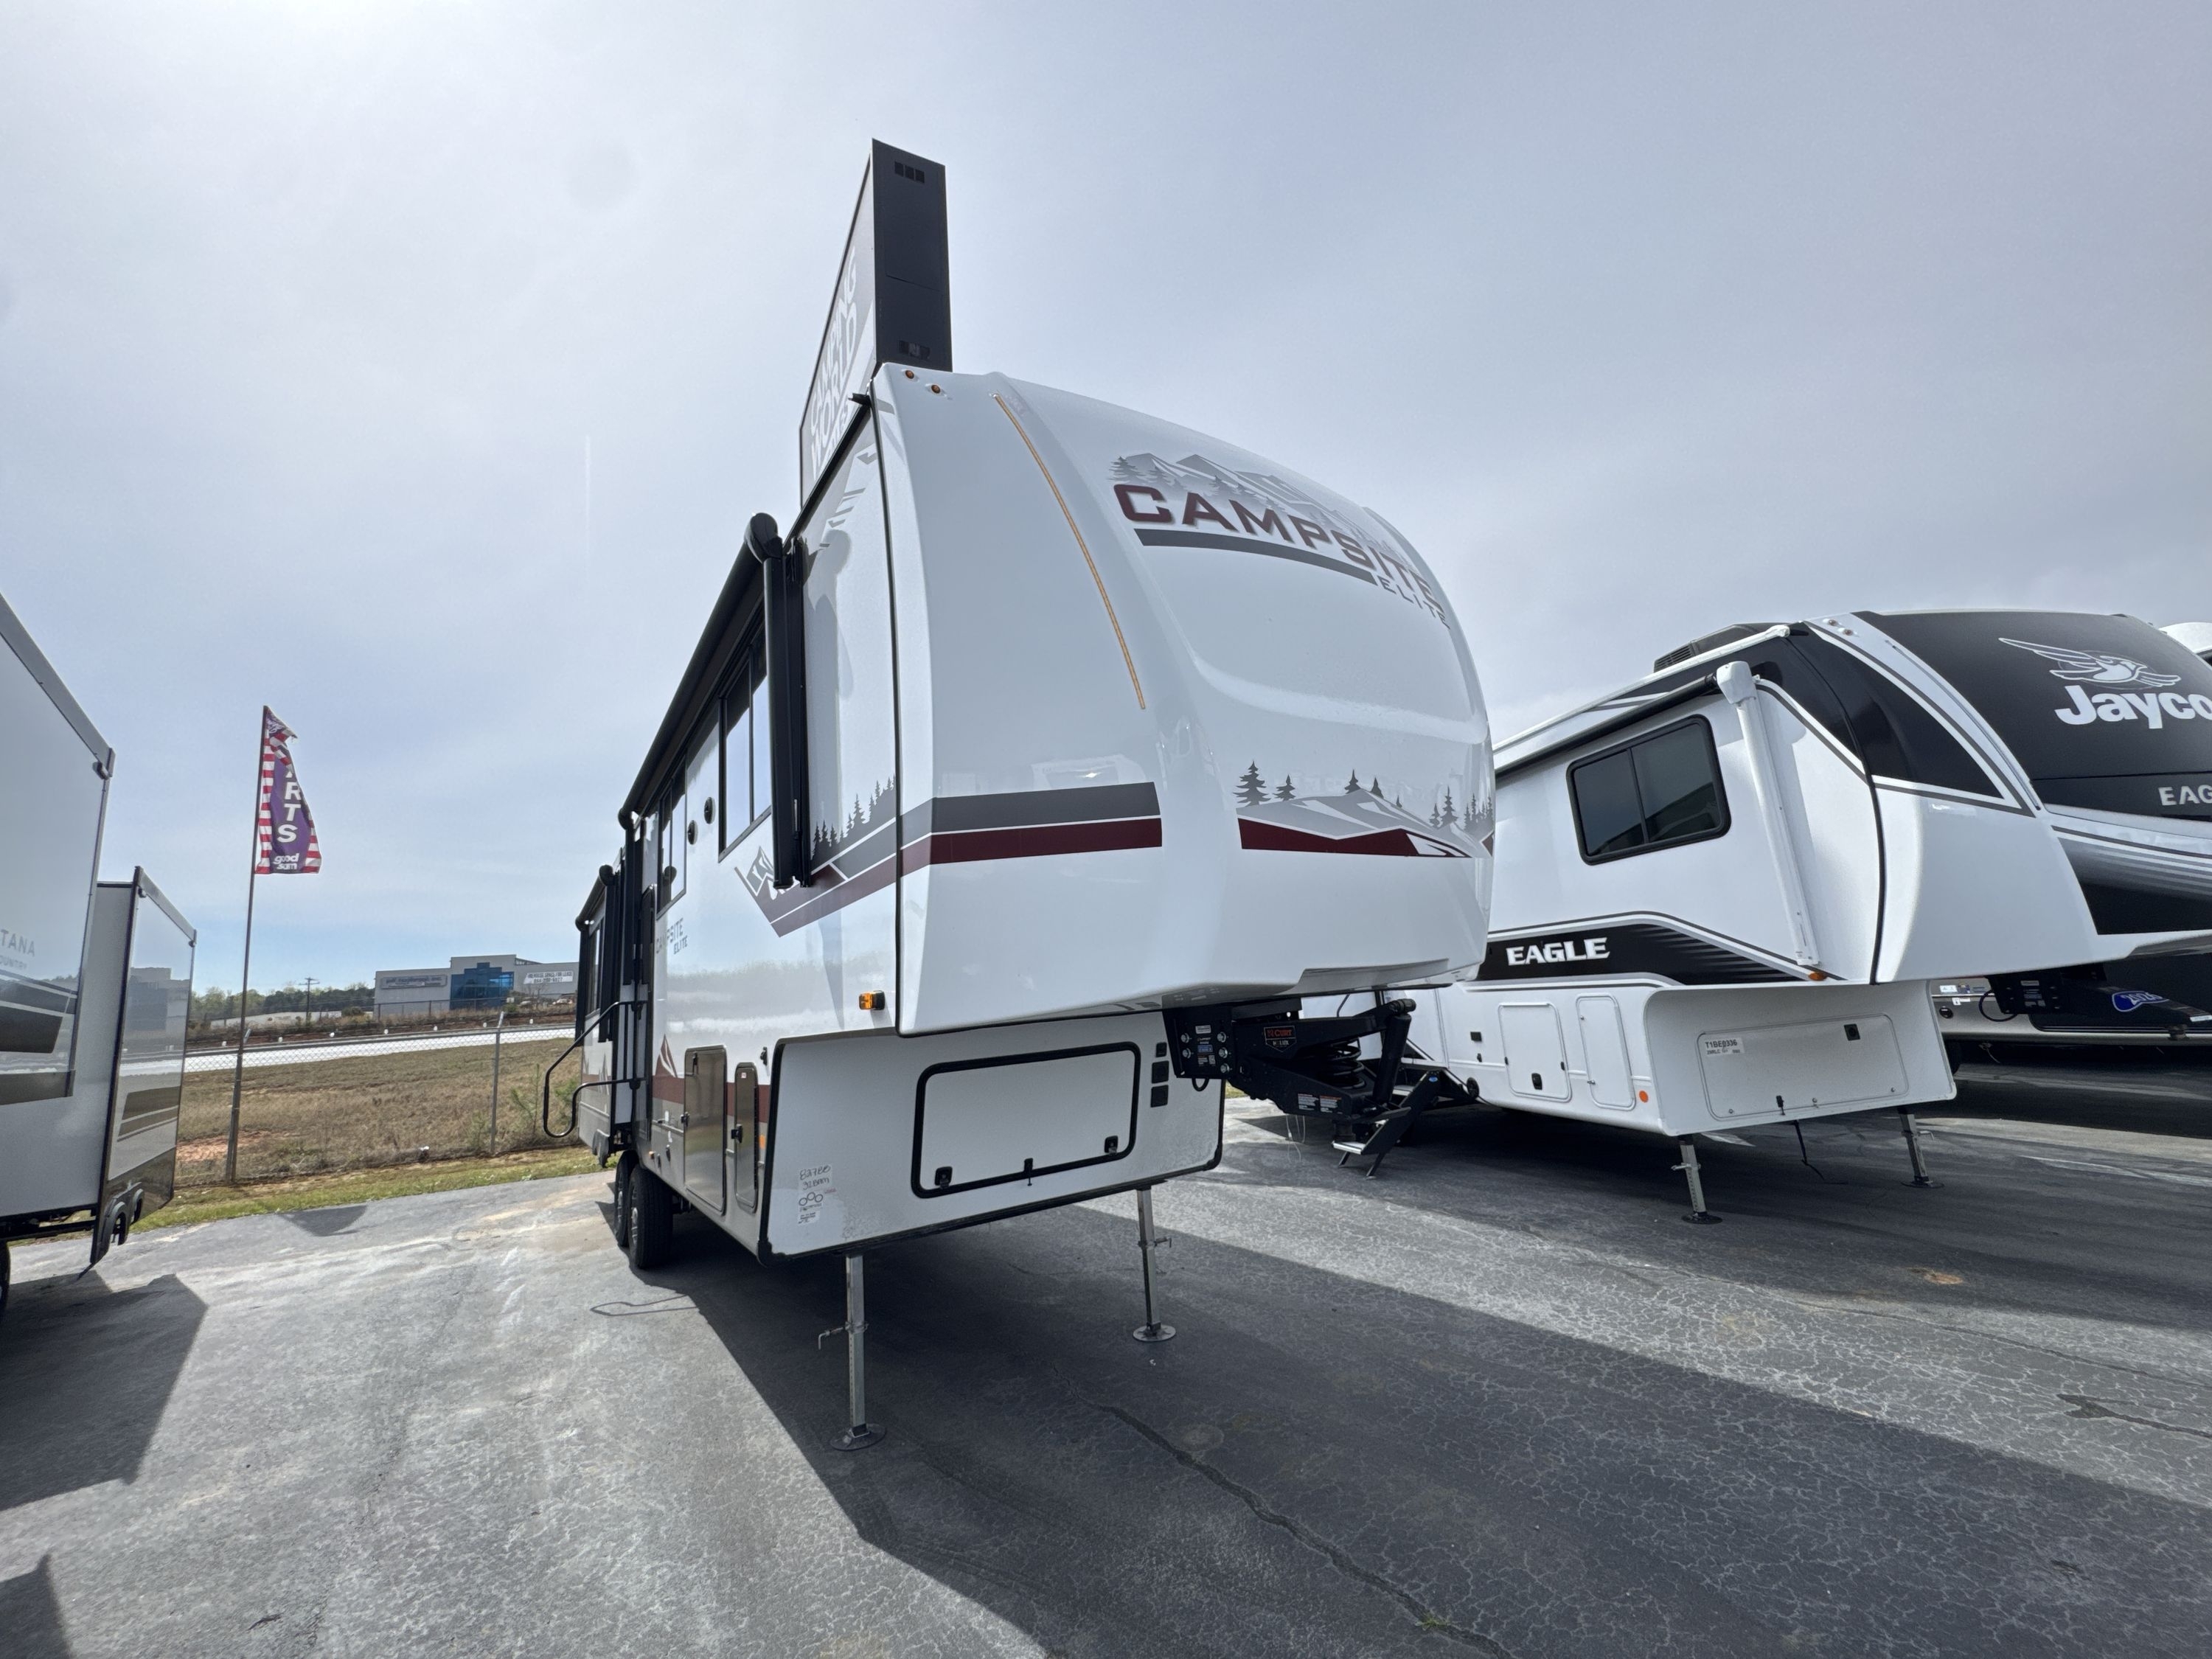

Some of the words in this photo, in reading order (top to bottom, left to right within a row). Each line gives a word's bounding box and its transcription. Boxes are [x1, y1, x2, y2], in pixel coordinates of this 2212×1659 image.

[811, 246, 856, 436] CAMPING
[811, 302, 856, 481] WORLD
[1113, 484, 1444, 613] CAMPSITE
[1377, 576, 1450, 629] ELITE
[2054, 685, 2212, 729] Jayco
[273, 852, 299, 865] good
[276, 861, 298, 870] sam
[1506, 936, 1610, 966] EAGLE
